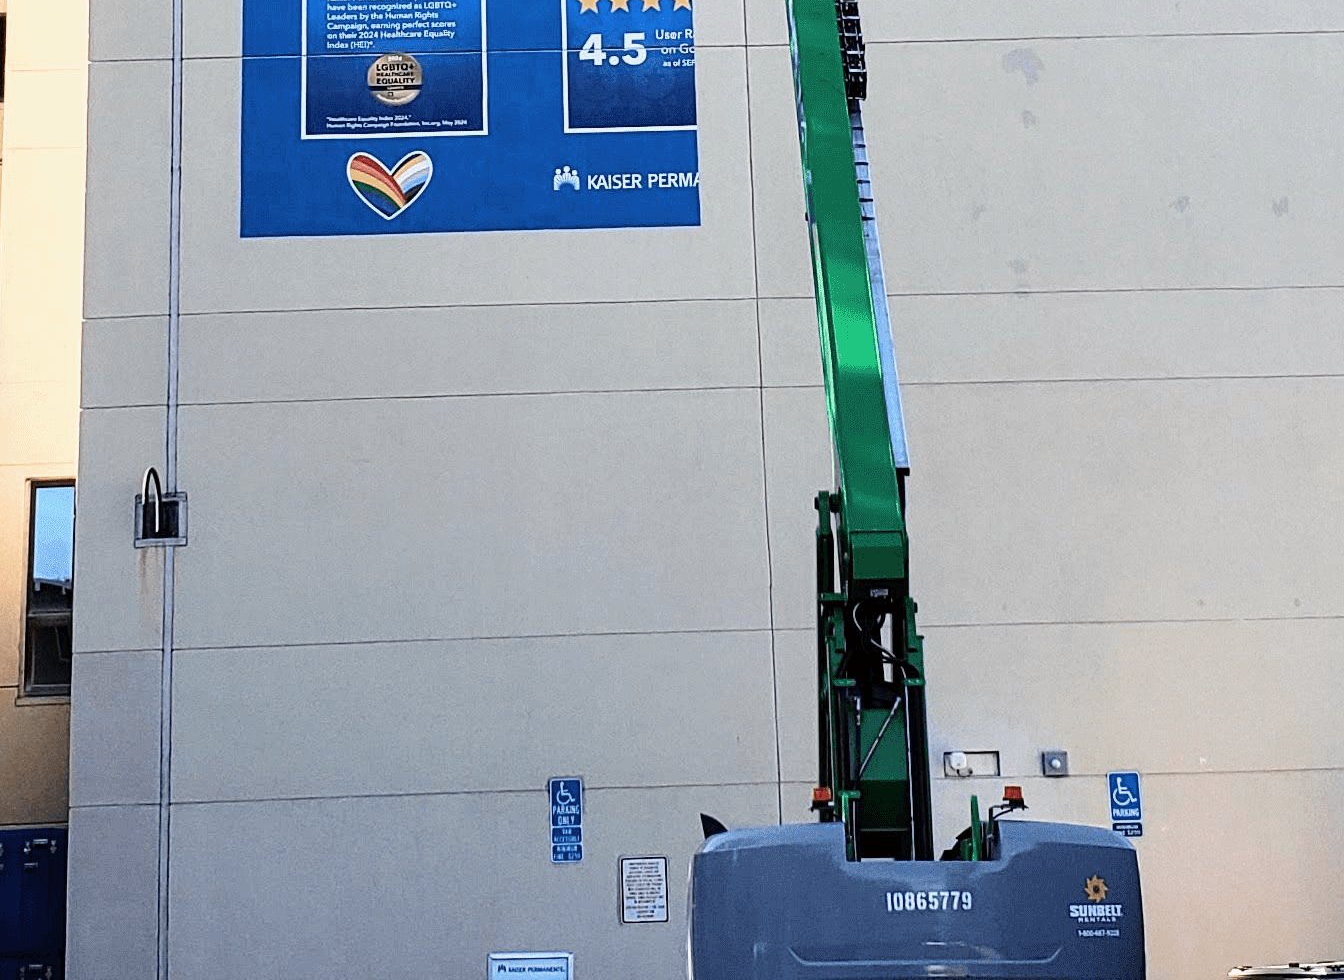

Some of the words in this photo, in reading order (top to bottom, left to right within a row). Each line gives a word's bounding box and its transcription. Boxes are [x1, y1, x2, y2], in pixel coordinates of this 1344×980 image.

[656, 29, 681, 39] User
[579, 32, 647, 65] 4.5
[588, 174, 642, 189] KAISER
[553, 805, 579, 815] PARKING
[1113, 808, 1139, 817] PARKING
[886, 892, 972, 911] 10865779
[1070, 905, 1122, 917] SUNBELT
